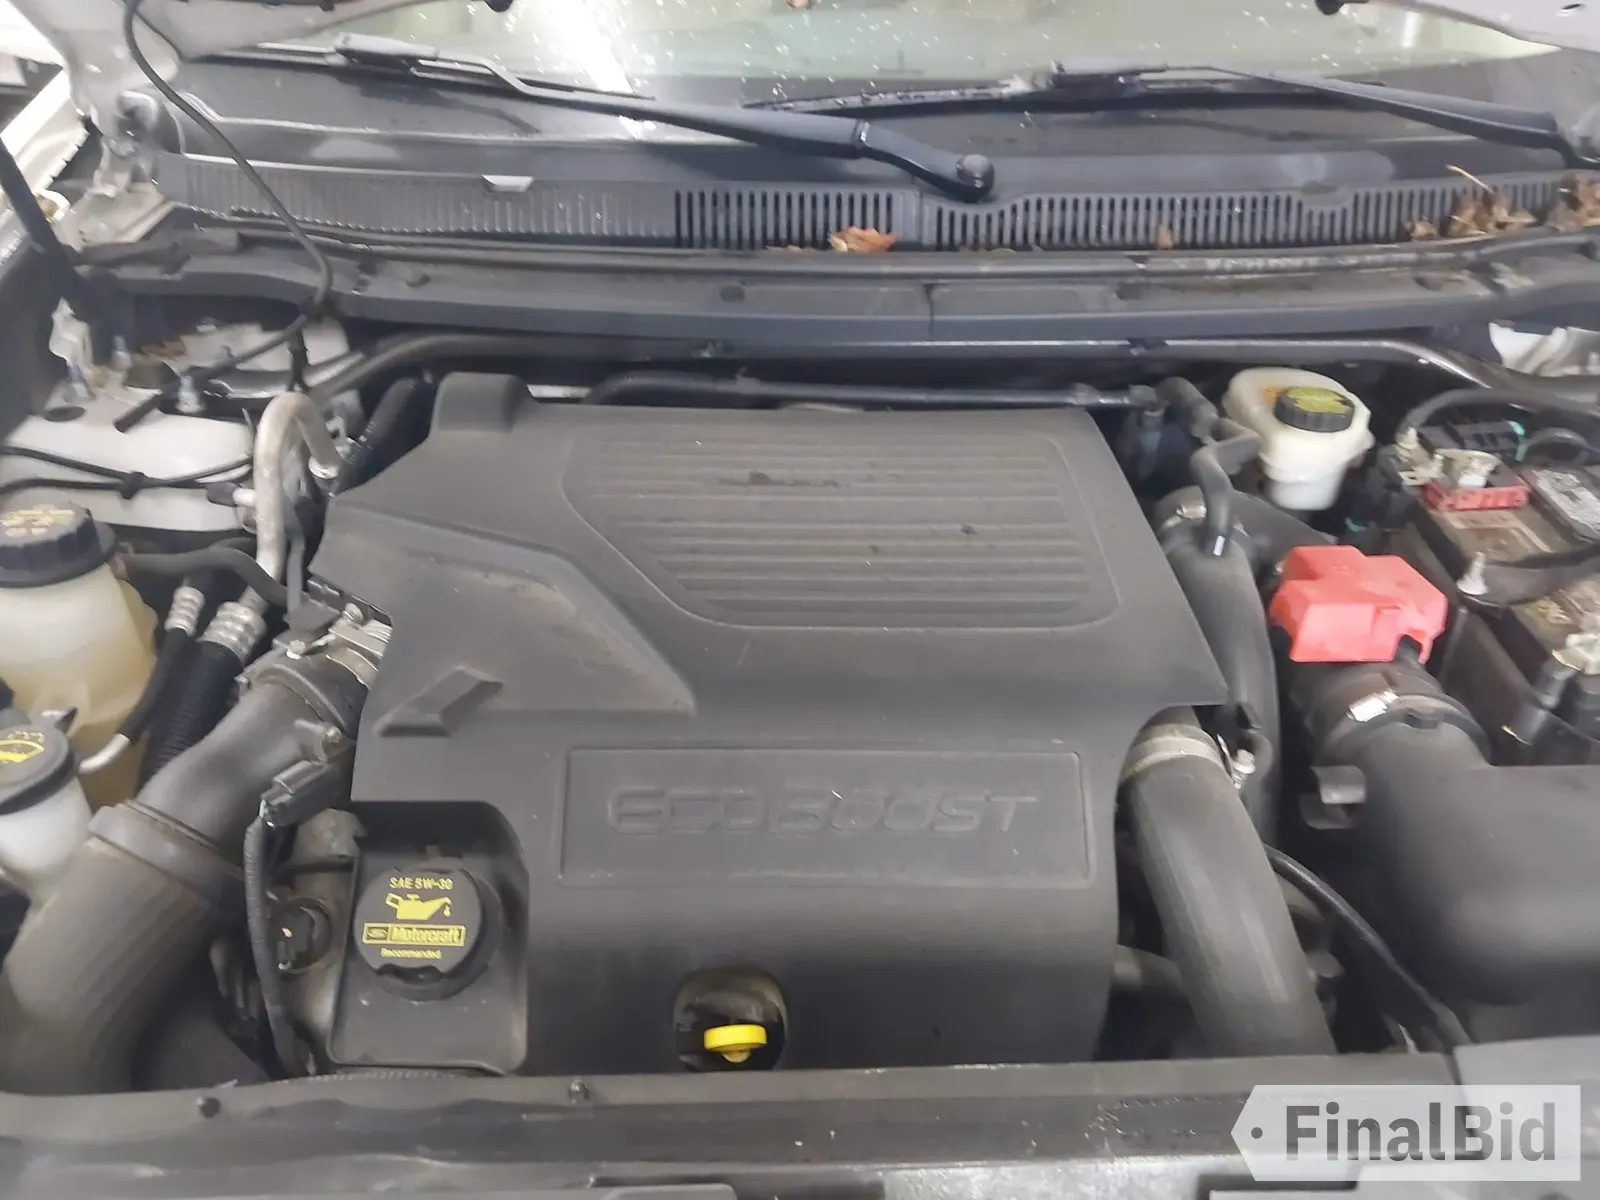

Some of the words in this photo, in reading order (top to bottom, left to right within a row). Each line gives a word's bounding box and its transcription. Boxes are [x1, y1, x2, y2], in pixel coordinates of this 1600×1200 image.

[607, 786, 1038, 835] ECOBOOST
[389, 877, 412, 889] SAE
[414, 877, 453, 890] 5W-30
[391, 926, 460, 943] Motorcraft
